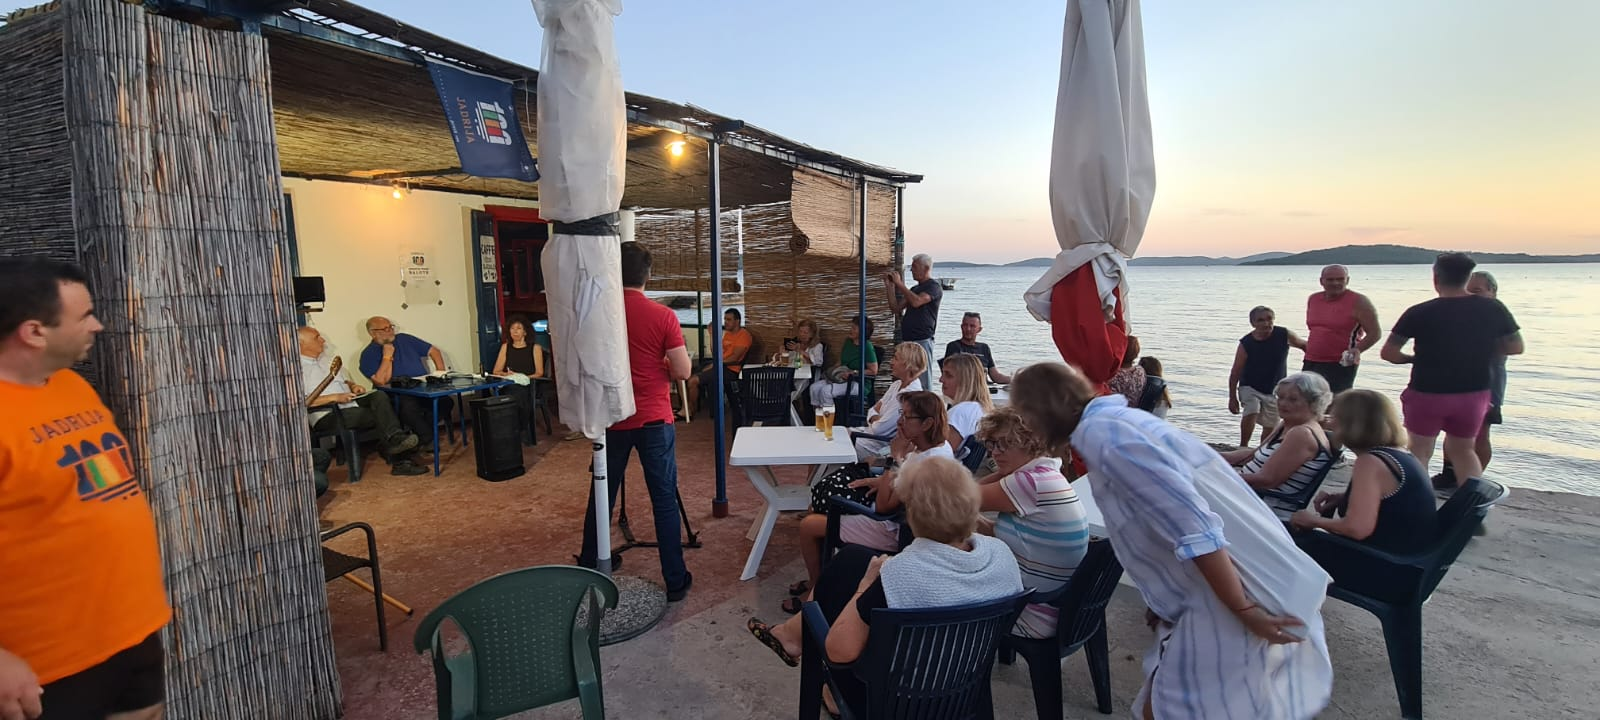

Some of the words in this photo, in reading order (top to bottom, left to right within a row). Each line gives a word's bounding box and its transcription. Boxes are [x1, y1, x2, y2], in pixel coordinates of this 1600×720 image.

[456, 97, 475, 144] JADRIJA
[29, 409, 104, 444] JADRIJA
[56, 432, 135, 495] 100
